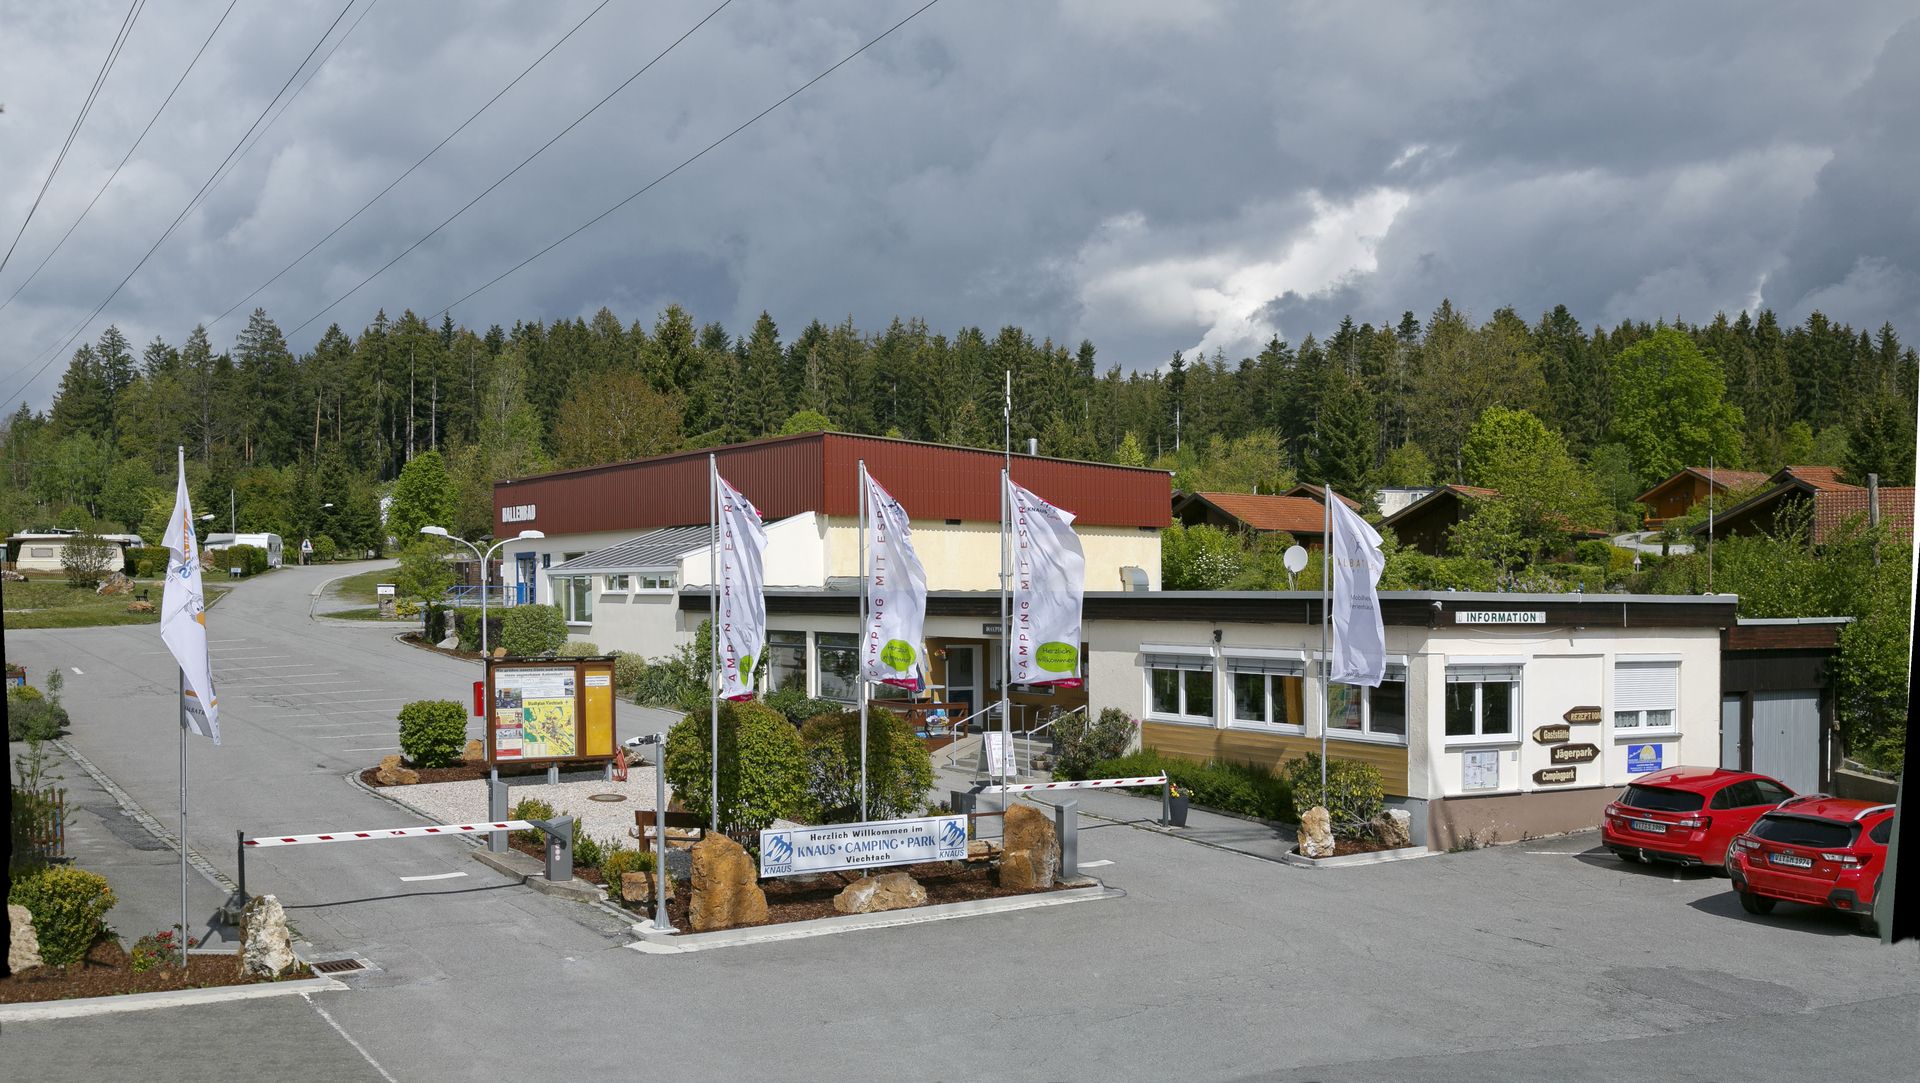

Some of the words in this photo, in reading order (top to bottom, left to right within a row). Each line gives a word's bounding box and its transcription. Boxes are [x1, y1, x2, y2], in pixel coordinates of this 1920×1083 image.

[875, 555, 886, 586] MIT
[1021, 560, 1030, 590] MIT
[1466, 612, 1537, 623] INFORMATION
[1018, 601, 1030, 680] CAMPING
[1555, 747, 1593, 760] Jägerpark
[1542, 769, 1575, 782] Campingpark
[810, 832, 848, 841] Herzlich
[852, 828, 908, 838] Willkommen
[797, 844, 836, 858] KNAUS
[845, 838, 898, 854] CAMPING
[907, 835, 936, 848] PARK
[846, 853, 891, 863] Viechtach
[939, 849, 965, 858] KNAUS
[764, 865, 792, 875] KNAUS
